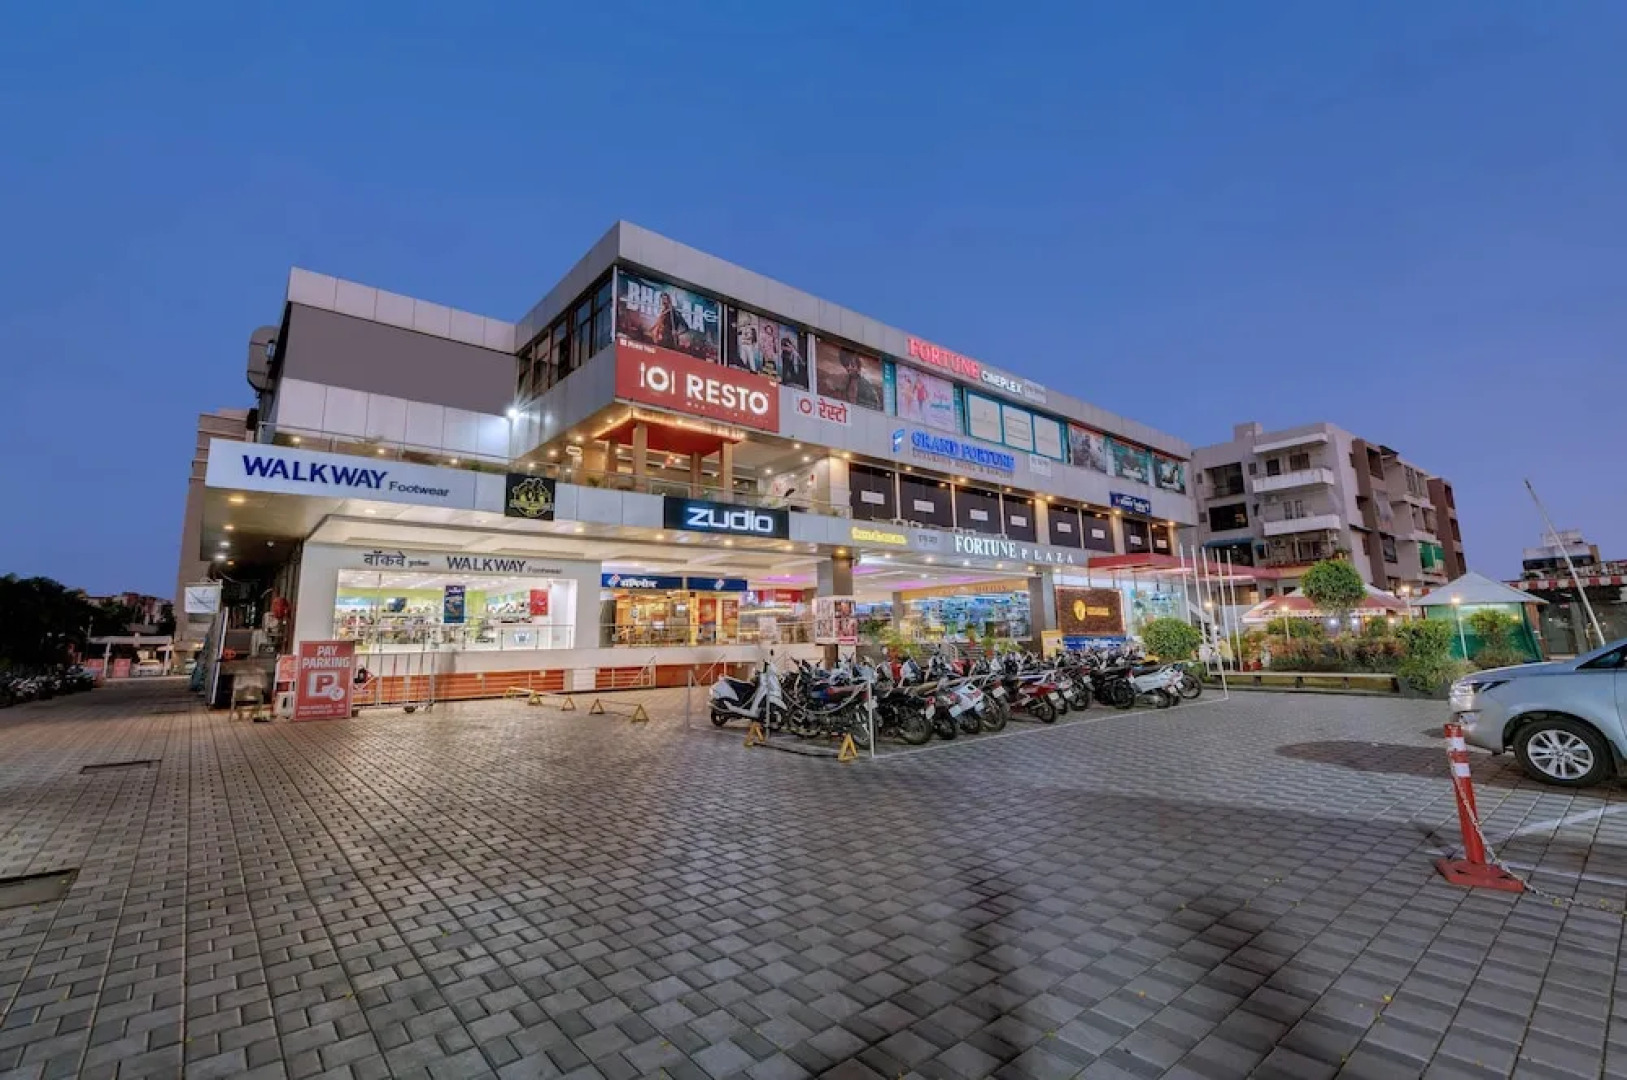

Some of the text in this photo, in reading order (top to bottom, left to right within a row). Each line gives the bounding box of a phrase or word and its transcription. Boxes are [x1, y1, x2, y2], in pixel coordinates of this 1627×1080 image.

[907, 337, 980, 379] FORTUNE
[981, 370, 1022, 393] CINEPLEX
[686, 373, 769, 416] RESTO
[911, 429, 958, 456] GRAND
[961, 443, 1015, 472] FORTUNE
[242, 455, 449, 497] WALKWAY Footwear
[955, 534, 1016, 559] FORTUNE
[447, 556, 526, 573] WALKWAY
[302, 657, 351, 669] PARKING
[316, 645, 338, 657] PAY
